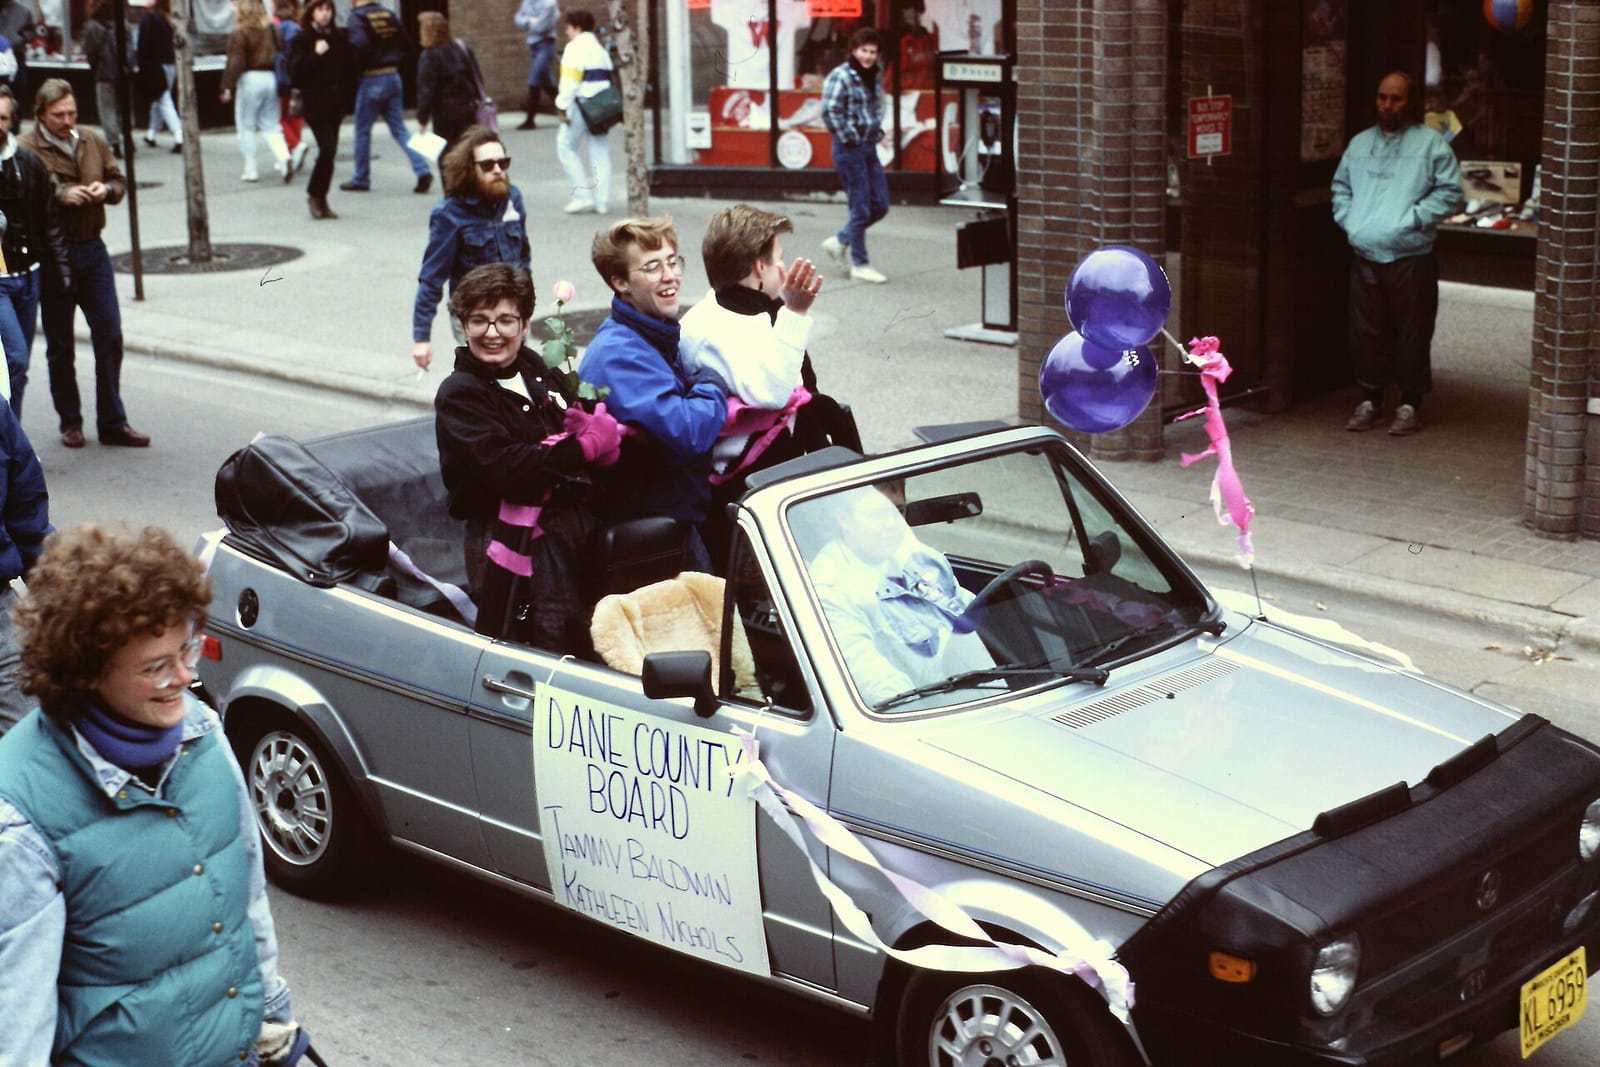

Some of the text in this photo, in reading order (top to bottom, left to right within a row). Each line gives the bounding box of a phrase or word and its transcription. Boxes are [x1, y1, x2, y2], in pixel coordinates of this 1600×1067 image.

[549, 697, 743, 797] DANE COUNTY
[587, 763, 690, 840] BOARD
[544, 805, 732, 906] TAMMY BALDWIN
[562, 863, 744, 963] KATHLEEN NICHOLS
[1523, 996, 1544, 1039] KL
[1548, 966, 1584, 1020] 6959
